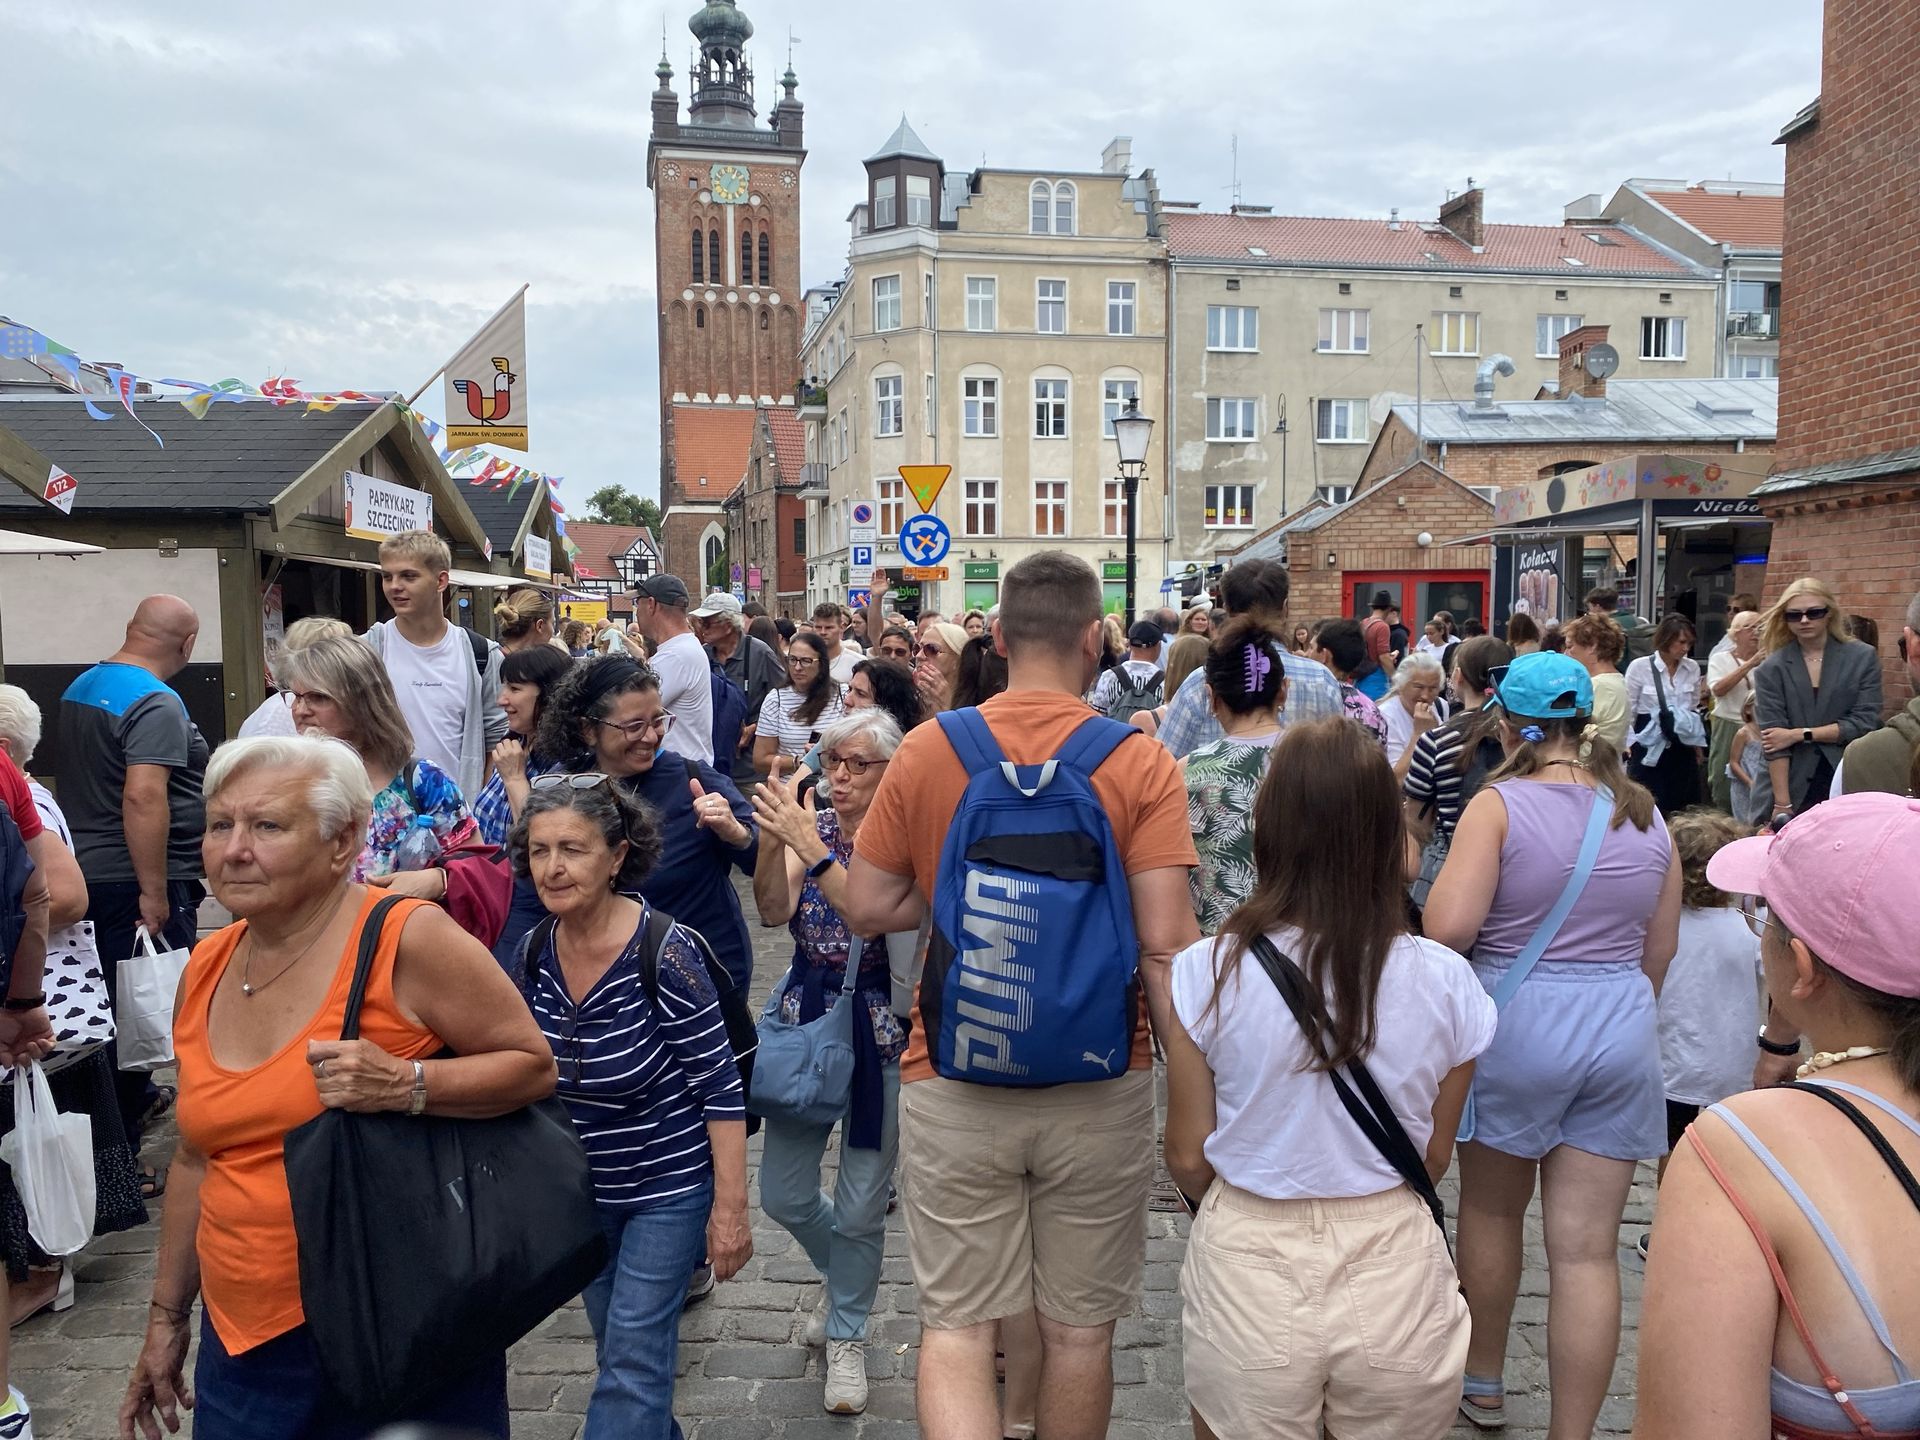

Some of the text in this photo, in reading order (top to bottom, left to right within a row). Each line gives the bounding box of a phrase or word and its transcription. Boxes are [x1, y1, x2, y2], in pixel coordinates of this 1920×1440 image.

[52, 479, 68, 493] 172
[369, 488, 415, 515] PAPRYKARZ
[1519, 548, 1557, 570] Kołaczy
[954, 869, 1039, 1077] PUMA
